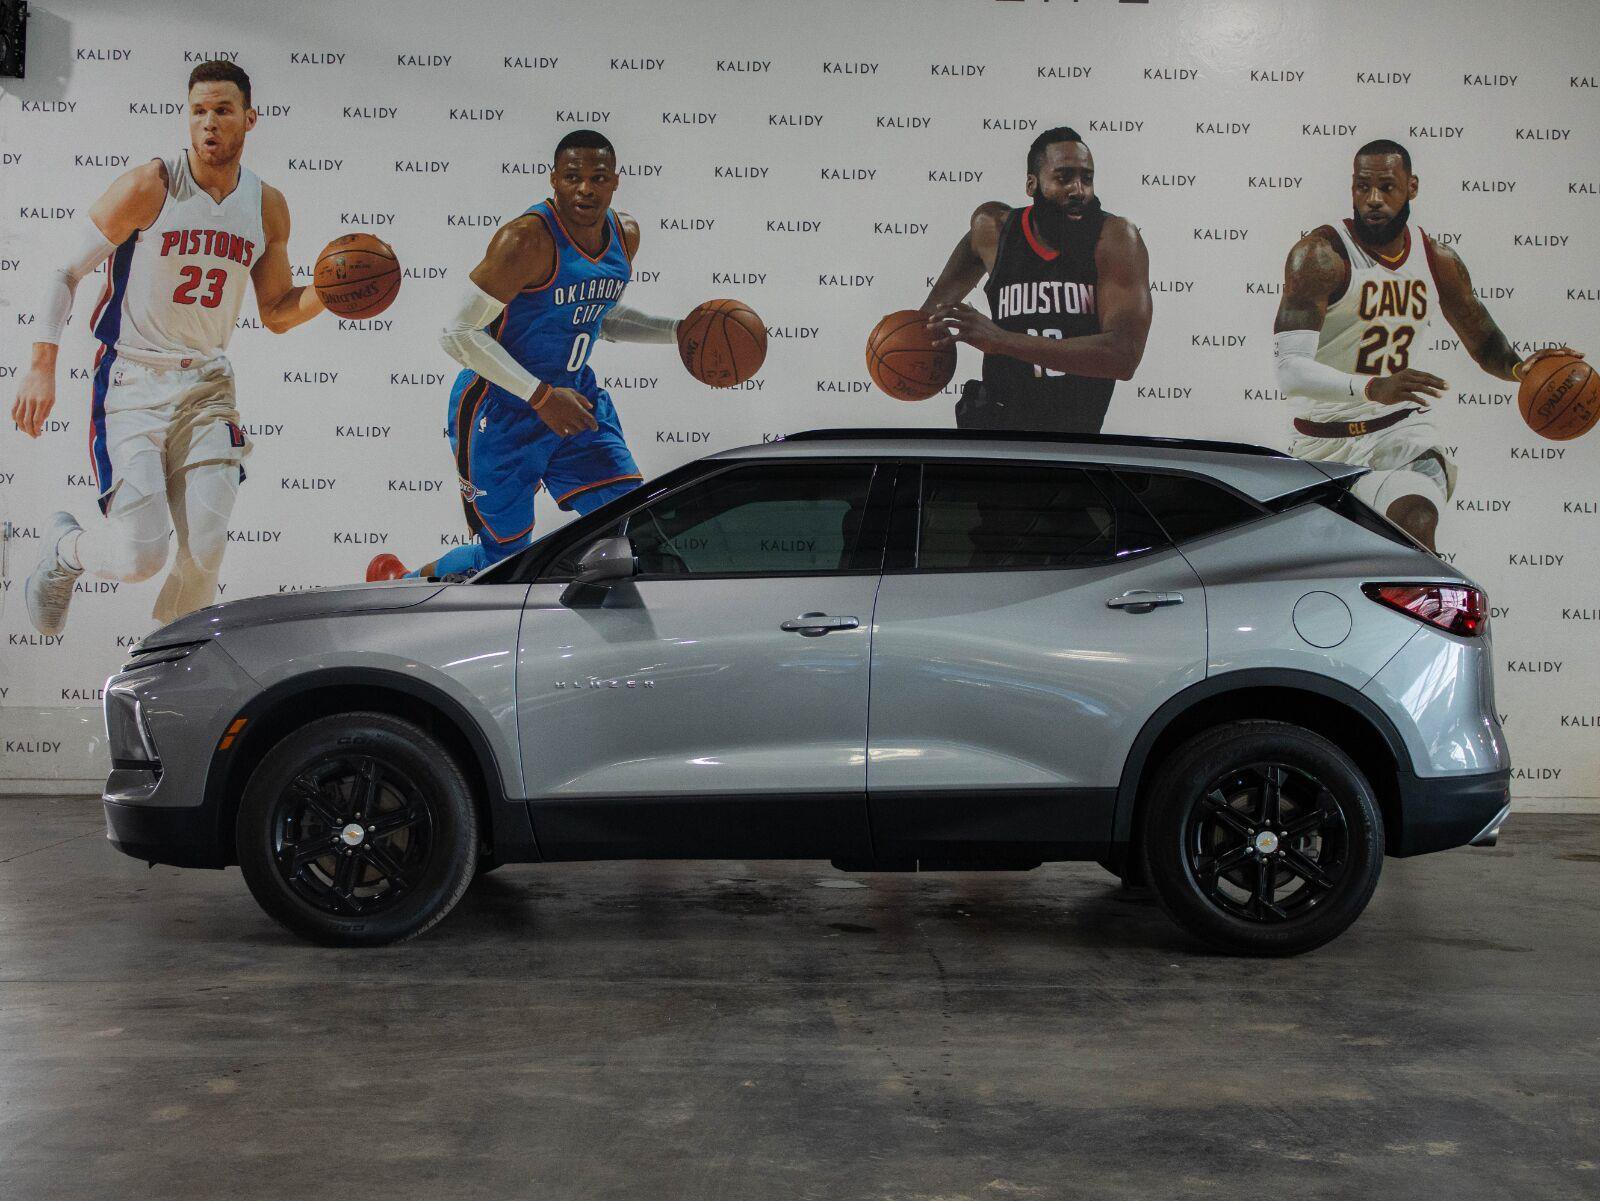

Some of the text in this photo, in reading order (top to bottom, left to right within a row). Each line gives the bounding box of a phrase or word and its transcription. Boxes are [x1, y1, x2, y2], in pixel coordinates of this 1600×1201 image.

[77, 49, 131, 60] KALIDY
[184, 51, 239, 62] KALIDY
[290, 53, 346, 64] KALIDY
[398, 55, 452, 66] KALIDY
[504, 57, 558, 68] KALIDY
[611, 59, 664, 70] KALIDY
[717, 61, 771, 72] KALIDY
[824, 62, 879, 74] KALIDY
[931, 64, 985, 76] KALIDY
[1038, 67, 1091, 78] KALIDY
[1144, 69, 1198, 80] KALIDY
[1249, 70, 1304, 82] KALIDY
[1357, 72, 1411, 84] KALIDY
[1464, 74, 1518, 86] KALIDY
[1570, 77, 1600, 89] KAL
[22, 101, 76, 112] KALIDY
[129, 103, 184, 114] KALIDY
[257, 106, 291, 118] LIDY
[344, 107, 397, 119] KALIDY
[450, 109, 504, 120] KALIDY
[556, 111, 610, 122] KALIDY
[663, 112, 716, 124] KALIDY
[769, 113, 823, 126] KALIDY
[877, 117, 931, 128] KALIDY
[983, 119, 1037, 130] KALIDY
[1089, 120, 1144, 132] KALIDY
[1196, 123, 1250, 134] KALIDY
[1303, 123, 1357, 136] KALIDY
[1410, 126, 1463, 138] KALIDY
[1516, 128, 1571, 140] KALIDY
[75, 155, 129, 167] KALIDY
[289, 159, 343, 170] KALIDY
[396, 161, 449, 172] KALIDY
[502, 163, 557, 175] KALIDY
[618, 165, 662, 177] ALIDY
[715, 166, 769, 178] KALIDY
[822, 168, 876, 180] KALIDY
[929, 170, 983, 182] KALIDY
[1142, 175, 1196, 186] KALIDY
[1249, 177, 1302, 188] KALIDY
[1462, 180, 1516, 192] KALIDY
[20, 207, 75, 219] KALIDY
[341, 213, 395, 224] KALIDY
[448, 215, 501, 226] KALIDY
[661, 219, 715, 230] KALIDY
[767, 221, 821, 232] KALIDY
[874, 223, 928, 234] KALIDY
[1194, 229, 1248, 240] KALIDY
[1514, 235, 1568, 246] KALIDY
[161, 230, 255, 267] PISTONS
[403, 267, 447, 279] ALIDY
[713, 273, 766, 285] KALIDY
[173, 265, 228, 308] 23
[819, 275, 874, 286] KALIDY
[1151, 281, 1194, 293] ALIDY
[1246, 283, 1286, 294] KALI
[998, 281, 1095, 320] HOUSTON
[1360, 279, 1427, 320] CAVS
[1566, 289, 1600, 301] KALI
[573, 304, 605, 325] CITY
[339, 320, 392, 331] KALIDY
[766, 326, 819, 338] KALIDY
[1192, 335, 1246, 346] KALIDY
[566, 333, 590, 372] 0
[1355, 325, 1415, 376] 23
[284, 371, 338, 383] KALIDY
[391, 374, 444, 385] KALIDY
[604, 377, 658, 388] KALIDY
[817, 381, 872, 392] KALIDY
[1138, 387, 1192, 398] KALIDY
[1457, 394, 1512, 406] KALIDY
[240, 425, 284, 437] ALIDY
[336, 426, 391, 437] KALIDY
[1348, 421, 1368, 435] CLE
[657, 431, 710, 443] KALIDY
[1511, 448, 1565, 459] KALIDY
[67, 474, 96, 486] KAL
[282, 478, 336, 489] KALIDY
[389, 480, 442, 491] KALIDY
[1457, 500, 1511, 512] KALIDY
[1564, 501, 1598, 514] KALI
[12, 527, 41, 539] KAL
[227, 531, 281, 543] KALIDY
[334, 532, 388, 544] KALIDY
[761, 541, 815, 553] KALIDY
[1509, 554, 1563, 566] KALIDY
[75, 582, 119, 594] ALIDY
[1562, 608, 1600, 620] KALI
[9, 634, 64, 646] KALIDY
[1507, 661, 1562, 672] KALIDY
[6, 741, 61, 752] KALIDY
